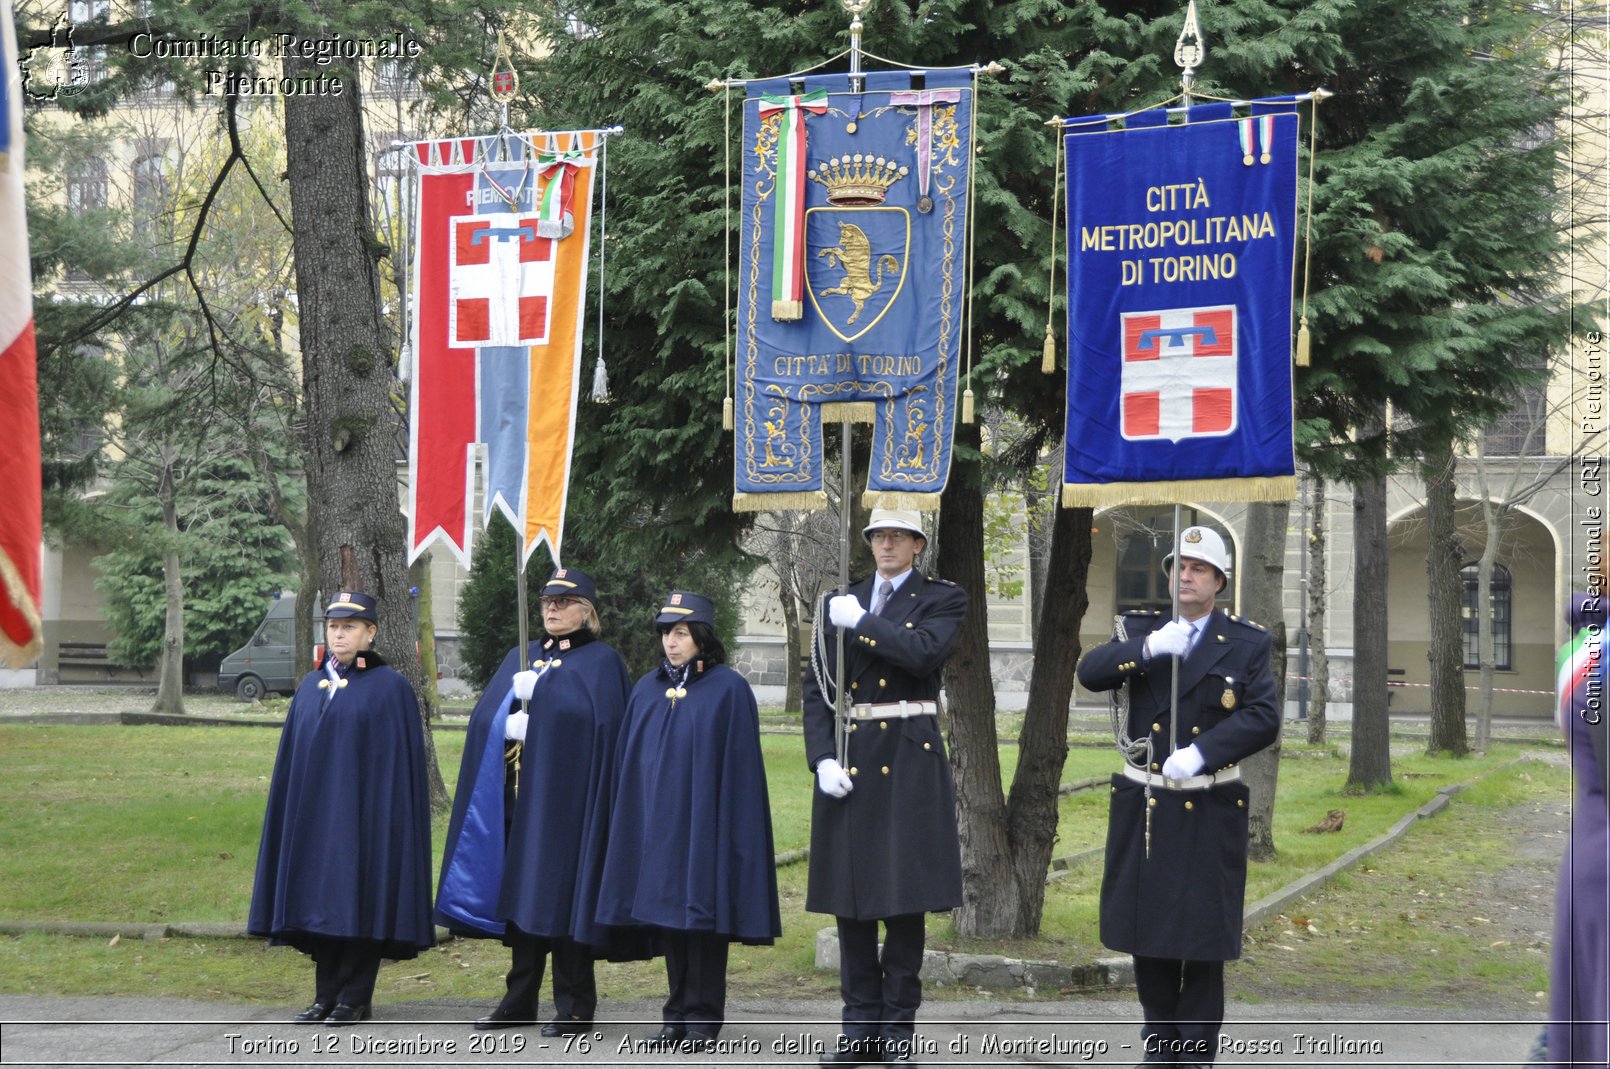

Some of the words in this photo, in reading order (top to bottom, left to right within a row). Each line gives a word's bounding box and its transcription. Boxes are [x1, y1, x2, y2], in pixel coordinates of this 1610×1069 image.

[466, 186, 543, 206] PIEMONTE
[1146, 177, 1210, 212] CITTÀ
[1081, 211, 1275, 251] METROPOLITANA
[1121, 259, 1143, 286] DI
[1149, 253, 1237, 284] TORINO
[836, 354, 850, 373] DI
[858, 355, 921, 376] TORINO
